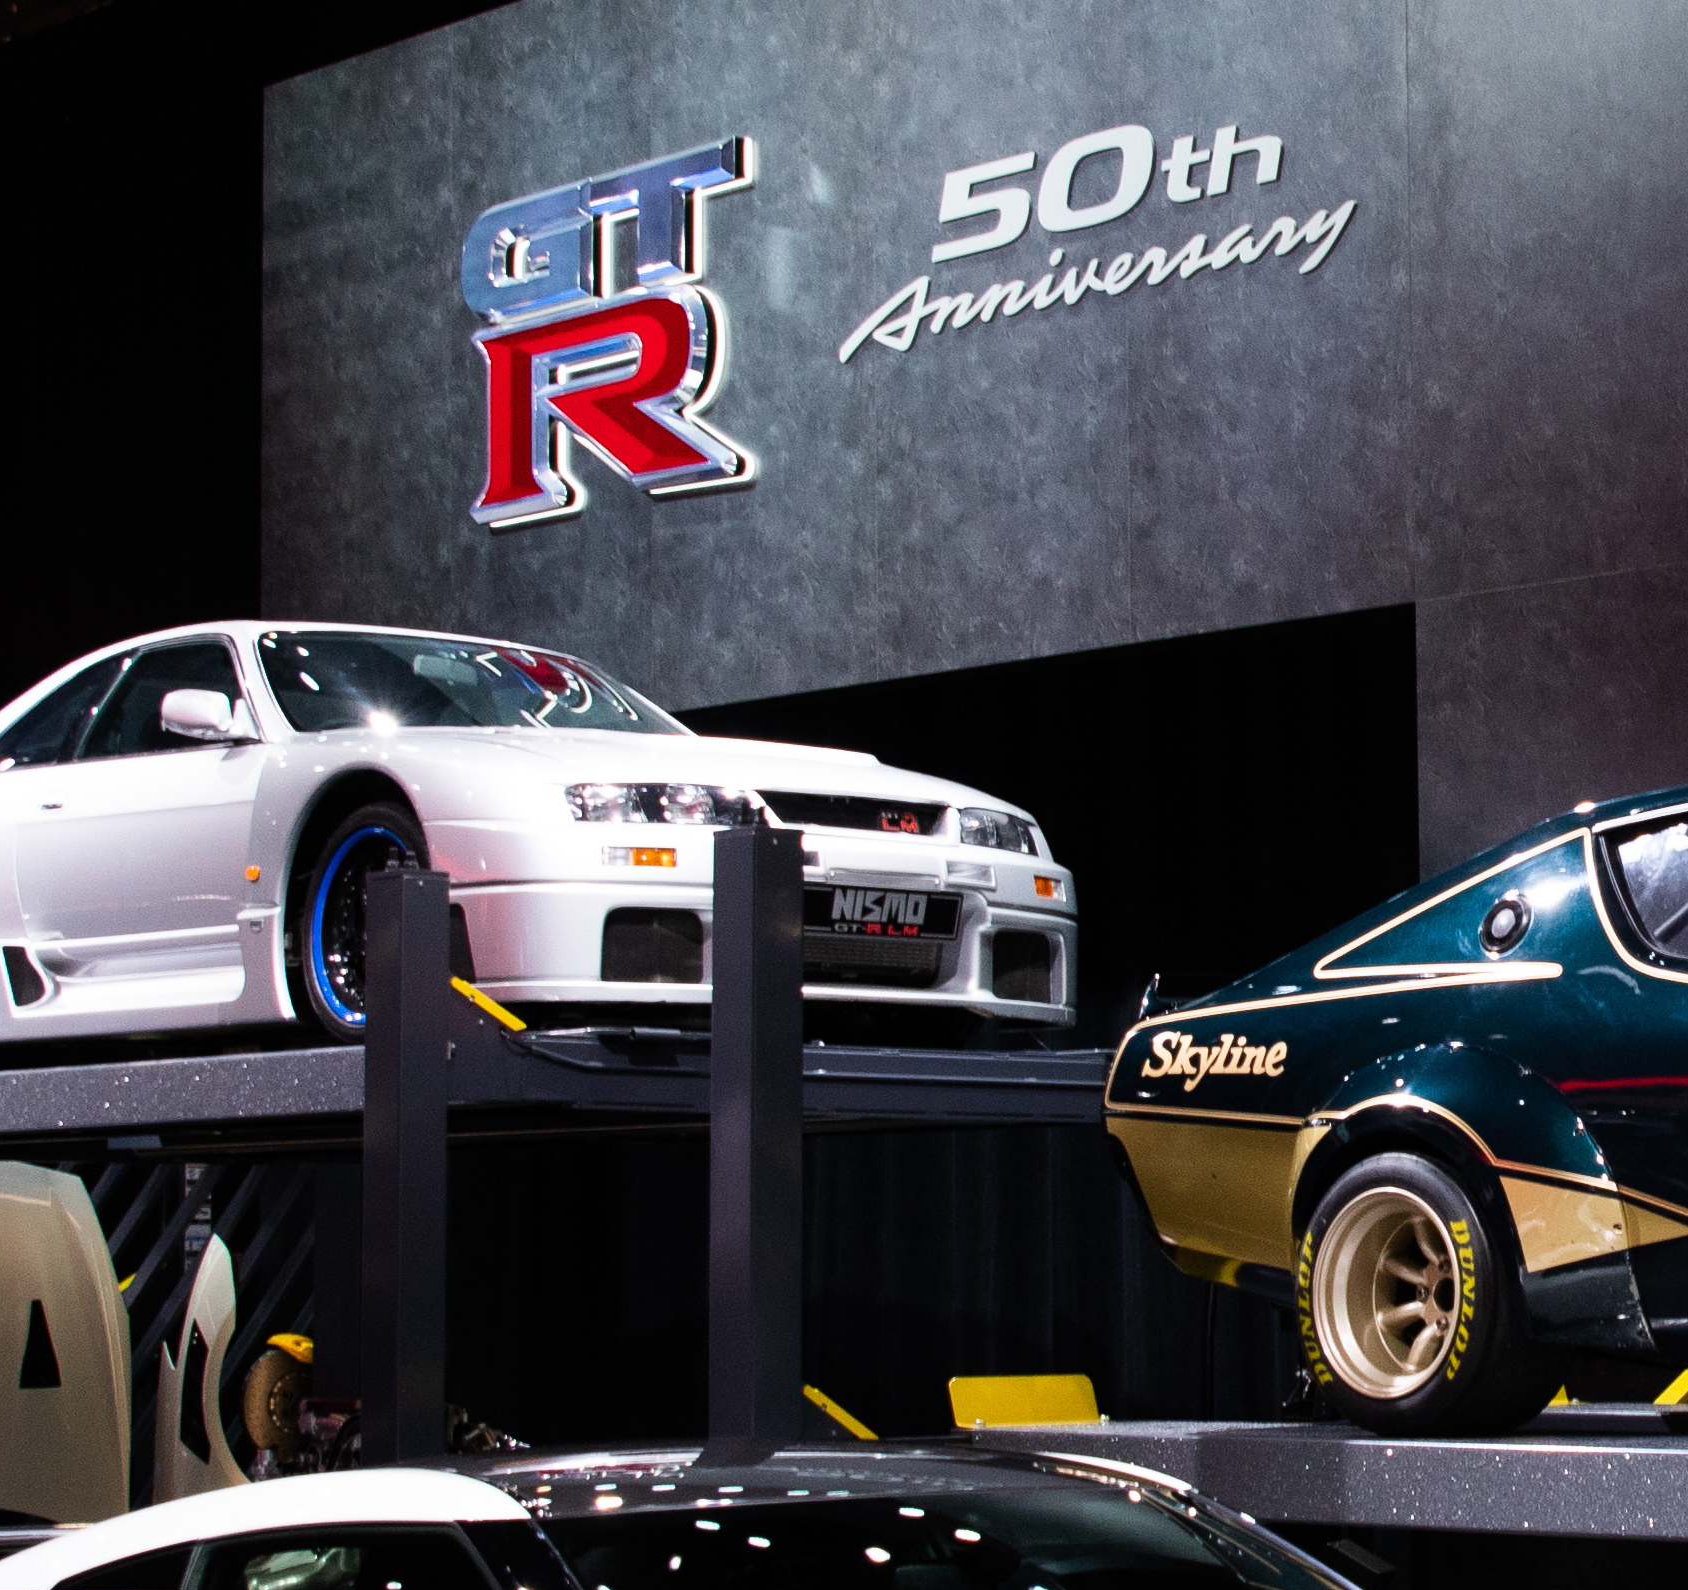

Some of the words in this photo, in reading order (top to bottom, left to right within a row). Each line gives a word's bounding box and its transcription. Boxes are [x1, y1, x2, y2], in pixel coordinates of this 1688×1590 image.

[931, 122, 1284, 263] 50th
[837, 199, 1356, 365] Anniversary
[831, 888, 928, 925] NISMO
[1140, 1030, 1289, 1092] Skyline
[1447, 1218, 1475, 1381] DUNLOP
